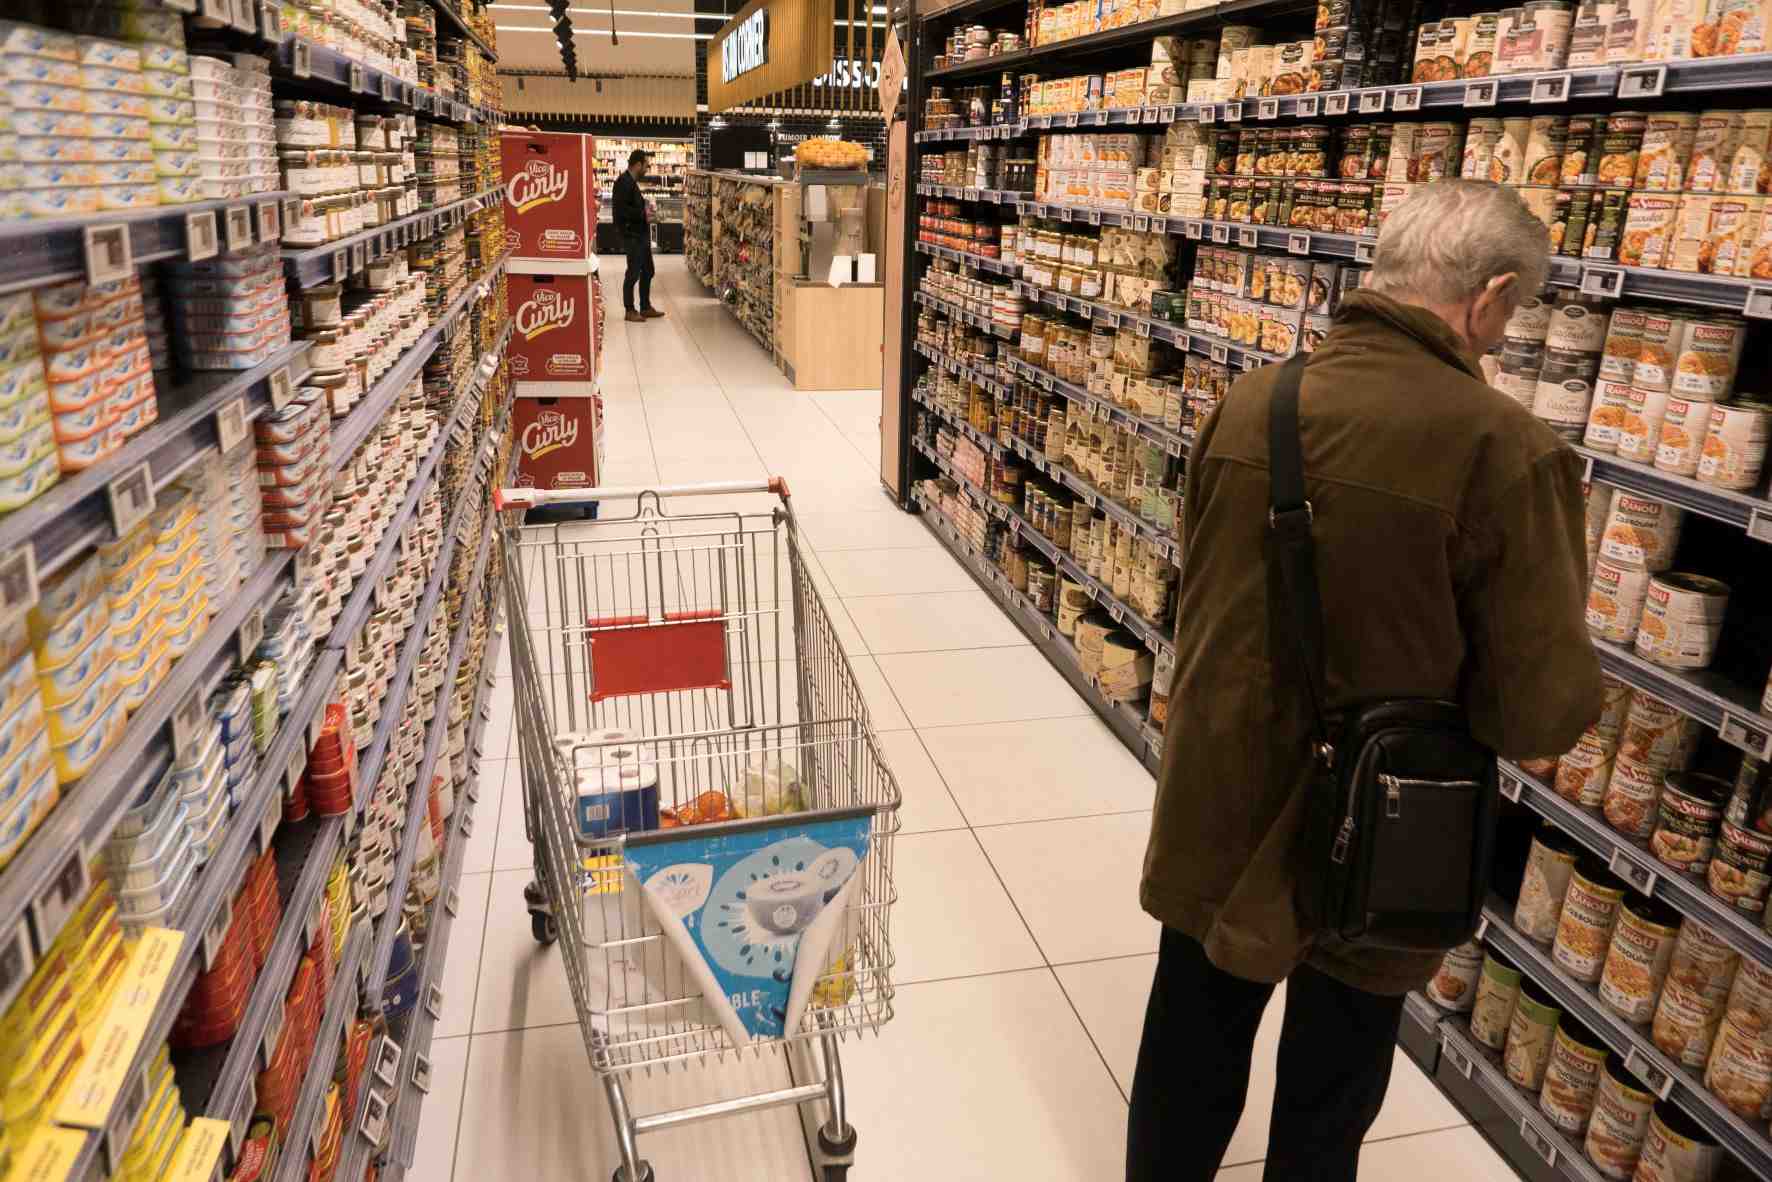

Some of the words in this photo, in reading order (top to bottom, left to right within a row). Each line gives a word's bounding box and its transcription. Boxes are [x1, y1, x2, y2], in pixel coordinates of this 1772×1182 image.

[507, 163, 569, 207] Curly
[515, 291, 575, 335] Curly
[521, 414, 578, 455] Curly
